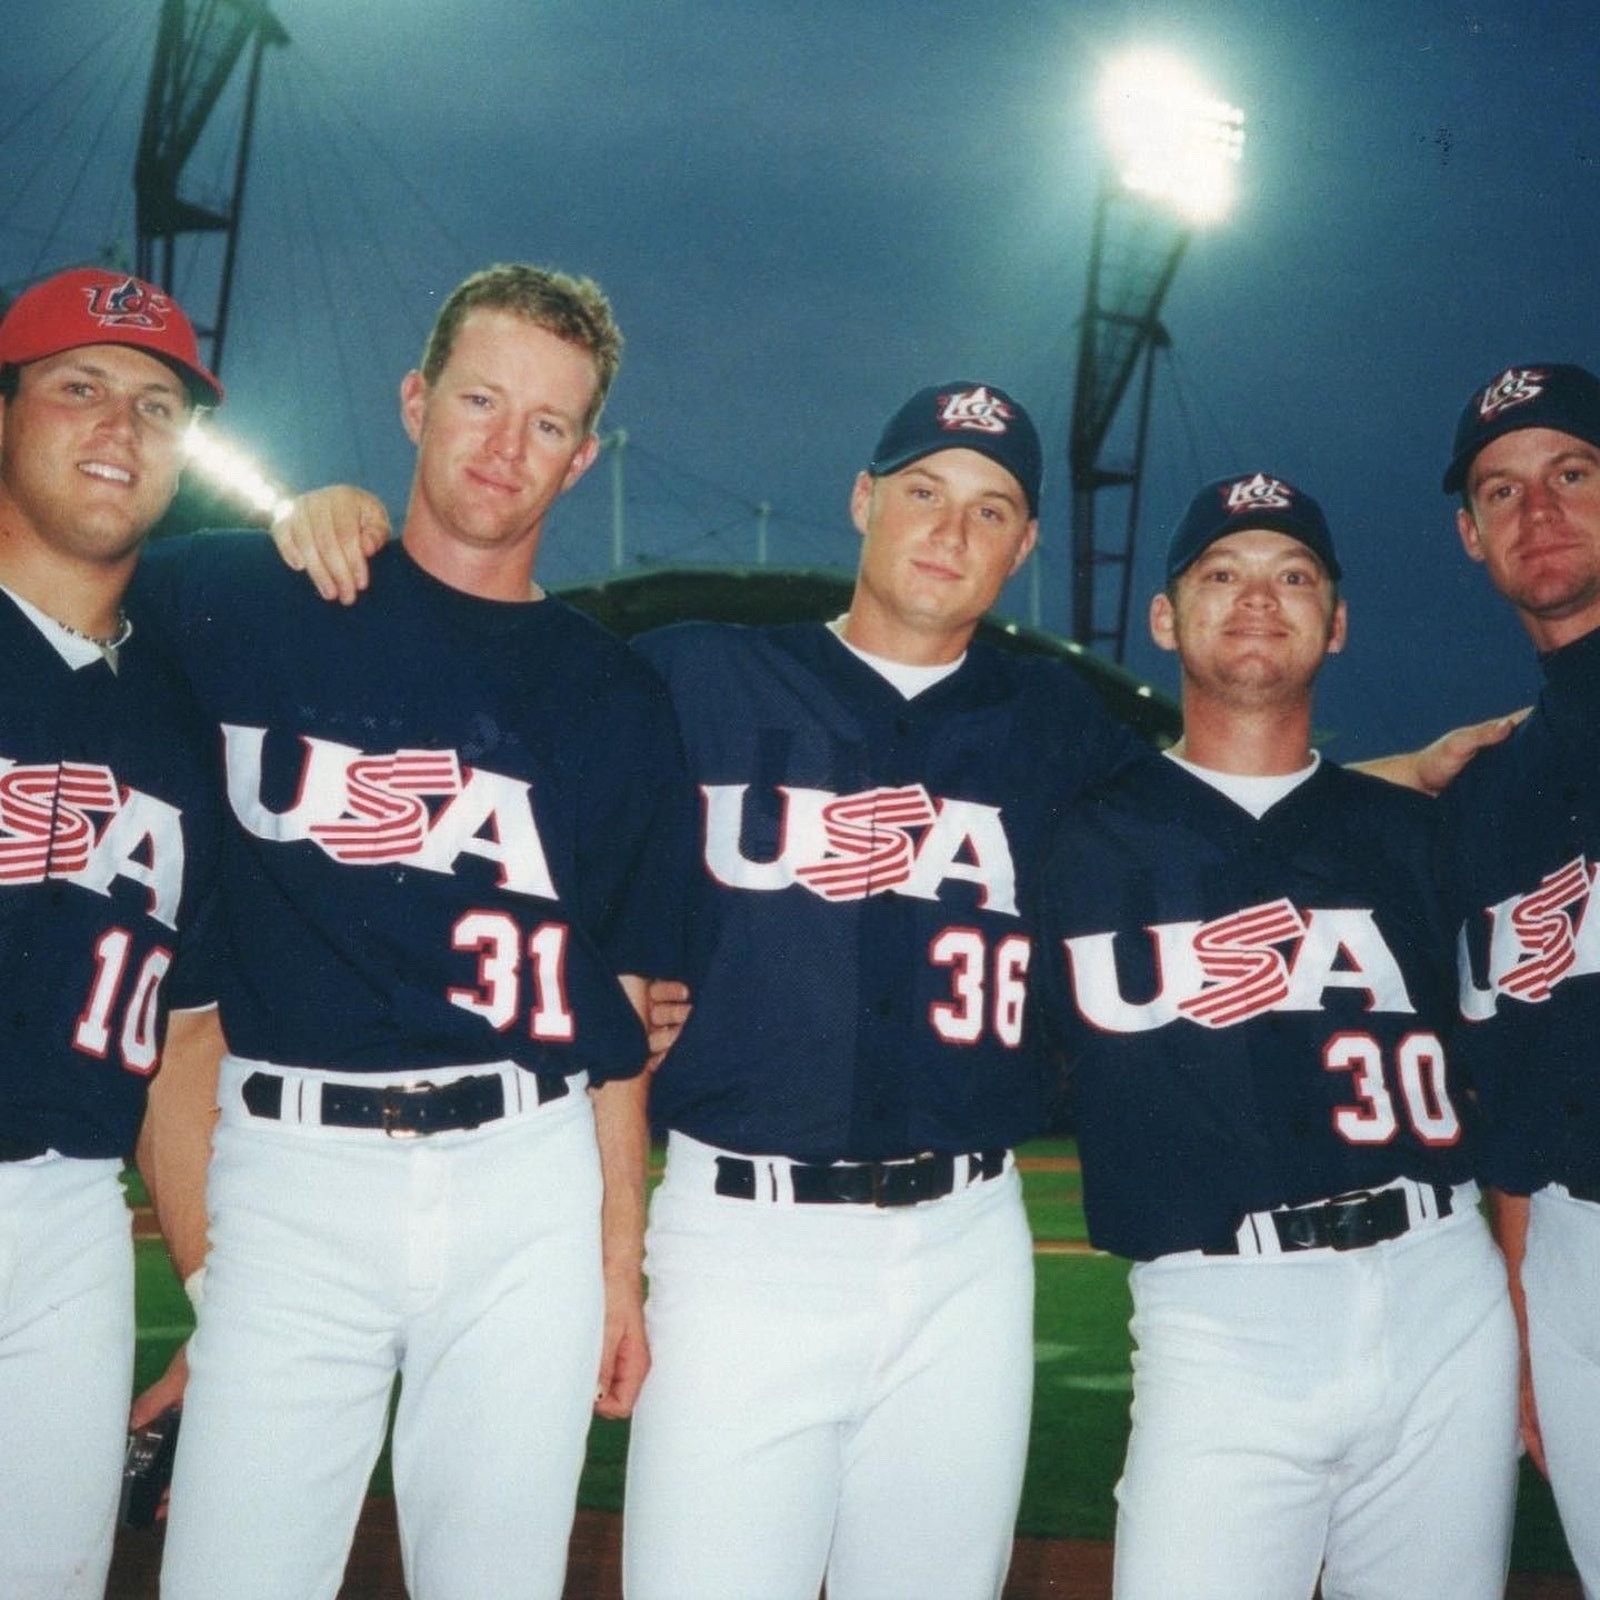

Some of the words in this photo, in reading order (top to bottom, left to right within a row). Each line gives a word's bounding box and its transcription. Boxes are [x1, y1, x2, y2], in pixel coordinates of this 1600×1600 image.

[0, 757, 185, 931] SA
[220, 722, 559, 900] USA
[698, 783, 1021, 917] USA
[72, 926, 174, 1076] 10
[447, 908, 575, 1043] 31
[929, 925, 1031, 1049] 36
[1063, 898, 1417, 1033] USA
[1322, 1030, 1461, 1147] 30
